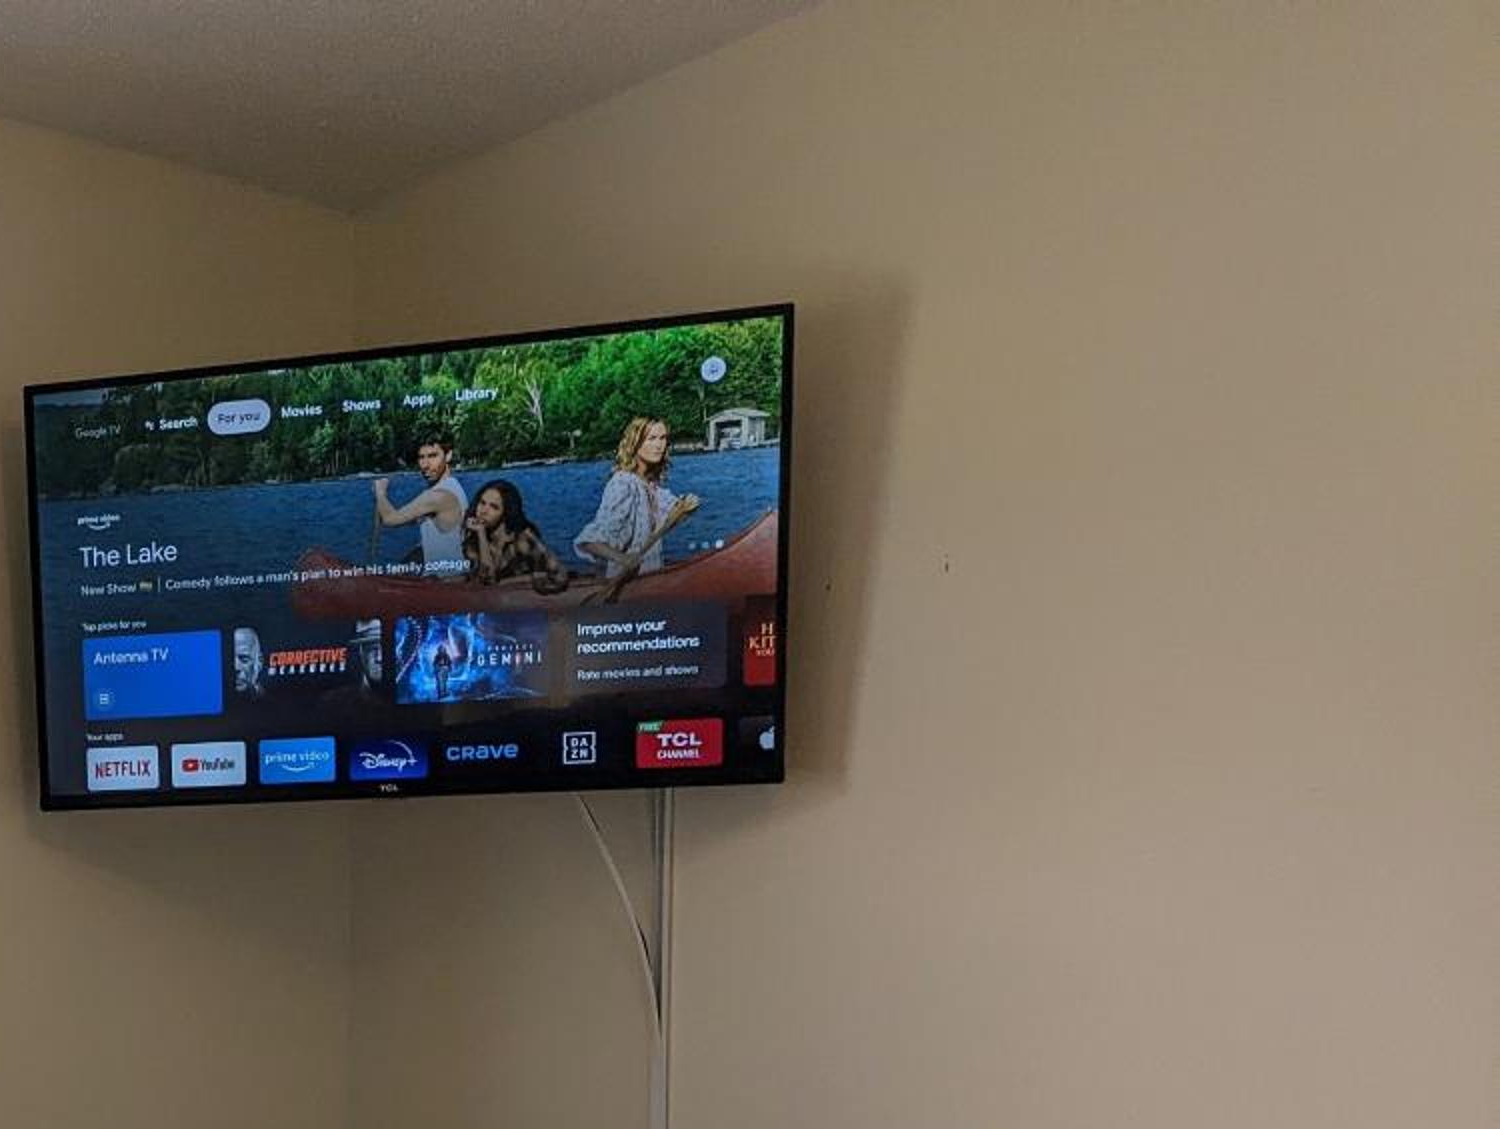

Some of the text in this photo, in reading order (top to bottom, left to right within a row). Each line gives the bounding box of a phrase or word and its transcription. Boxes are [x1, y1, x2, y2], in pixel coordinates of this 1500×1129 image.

[403, 393, 434, 408] Apps
[455, 387, 499, 402] Library
[280, 403, 323, 419] Movies
[342, 398, 382, 413] Shows
[159, 415, 198, 432] Search
[217, 411, 261, 426] For you
[75, 423, 122, 440] Google TV
[78, 540, 178, 568] The Lake
[81, 583, 105, 597] New
[106, 582, 137, 595] Show
[165, 576, 212, 590] Comedy
[213, 574, 255, 587] follows
[265, 570, 299, 583] man's
[301, 569, 327, 583] plan
[328, 567, 342, 579] to
[343, 565, 366, 577] win
[366, 563, 384, 576] his
[386, 561, 423, 575] family
[423, 558, 472, 574] cottage
[576, 619, 667, 640] Improve your
[576, 635, 701, 655] recommendations
[93, 647, 170, 666] Antenna TV
[268, 646, 348, 667] CORRECTIVE
[476, 650, 543, 667] GEMINI
[576, 664, 699, 681] Rate movies and shows
[656, 731, 703, 747] TCL
[264, 750, 330, 765] prime video
[656, 748, 701, 760] CHANNEL
[94, 758, 152, 779] NETFLIX
[199, 757, 235, 773] YouTube
